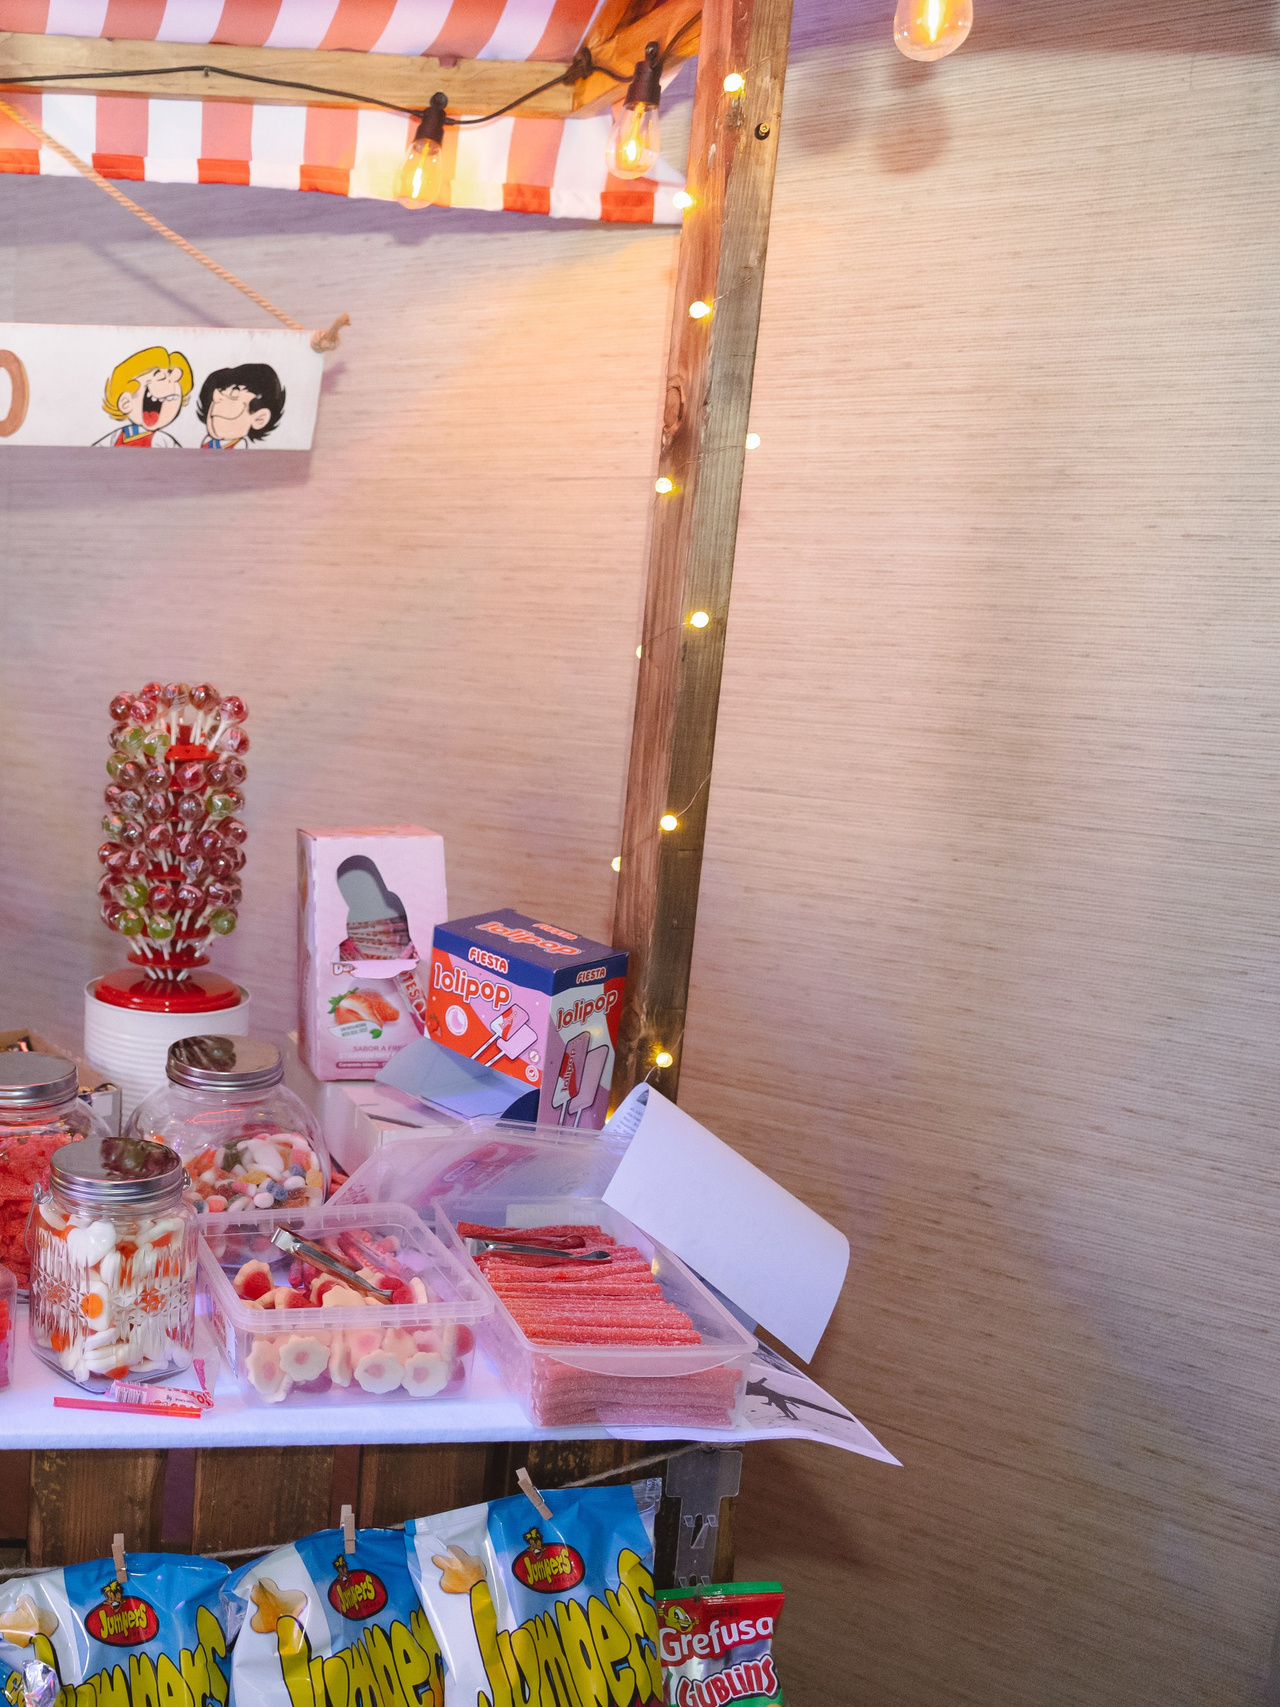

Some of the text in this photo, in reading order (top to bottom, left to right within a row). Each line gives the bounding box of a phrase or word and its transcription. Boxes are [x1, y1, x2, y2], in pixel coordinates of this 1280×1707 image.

[476, 922, 582, 956] lolipop
[532, 922, 579, 941] FIESTA
[469, 947, 509, 974] FIESTA
[575, 966, 608, 984] FIESTA
[433, 961, 512, 1010] lolipop
[556, 989, 619, 1032] lolipop
[524, 1548, 572, 1585] Jumpers
[339, 1574, 376, 1612] Jumpers
[99, 1602, 148, 1640] Jumpers
[470, 1548, 663, 1707] Jumpers
[659, 1616, 773, 1661] Grefusa
